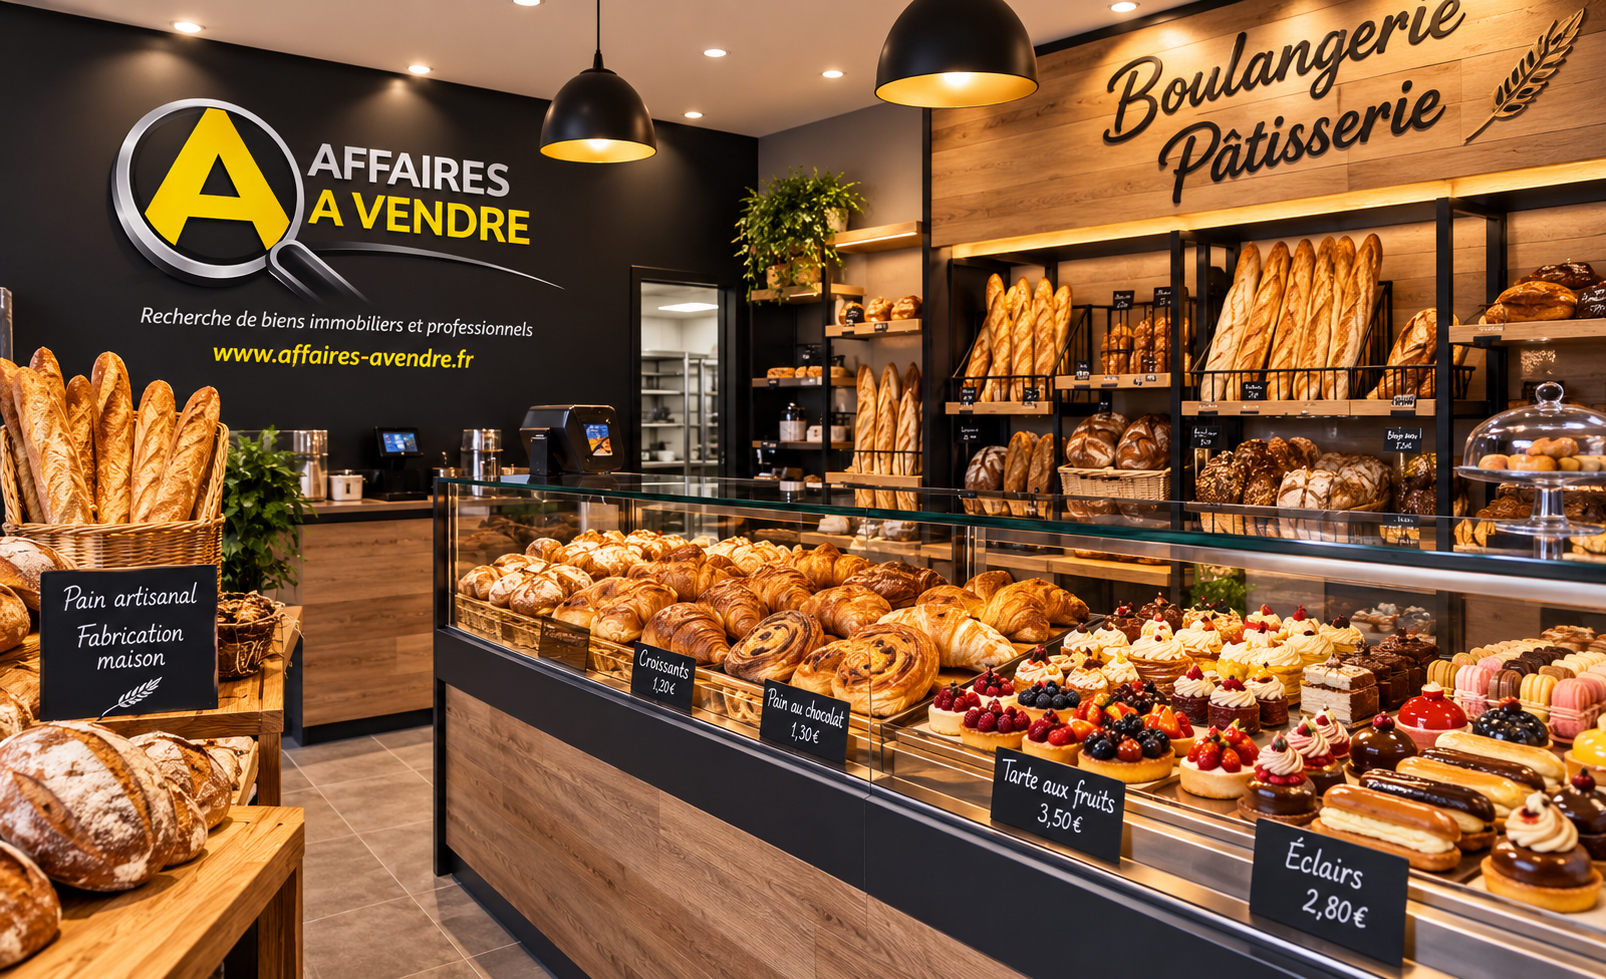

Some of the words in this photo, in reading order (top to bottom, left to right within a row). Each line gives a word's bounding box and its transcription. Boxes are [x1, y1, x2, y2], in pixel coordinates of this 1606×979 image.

[1102, 0, 1467, 144] Boulangerie
[1158, 80, 1447, 205] Pâtisserie
[144, 107, 291, 251] A
[307, 142, 510, 198] AFFAIRES
[307, 189, 345, 227] A
[351, 191, 531, 246] VENDRE
[140, 306, 232, 327] Recherche
[236, 309, 257, 328] de
[261, 310, 305, 330] biens
[309, 313, 404, 333] immobiliers
[407, 318, 424, 334] et
[425, 318, 534, 338] professionnels
[213, 343, 476, 370] www.affaires-avendre.fr
[63, 584, 107, 612] Pain
[114, 581, 199, 608] artisanal
[76, 623, 184, 648] Fabrication
[96, 649, 166, 671] maison
[638, 648, 690, 680] Croissants
[653, 677, 676, 696] 1,20€
[766, 687, 789, 711] Pain
[789, 701, 804, 716] au
[803, 700, 845, 729] chocolat
[790, 721, 820, 744] 1,30€
[1002, 758, 1039, 791] Tarte
[1042, 779, 1069, 801] aux
[1072, 779, 1117, 816] fruits
[1036, 802, 1084, 835] 3,50€
[1285, 836, 1365, 891] Éclairs
[1301, 888, 1370, 930] 2,80€
